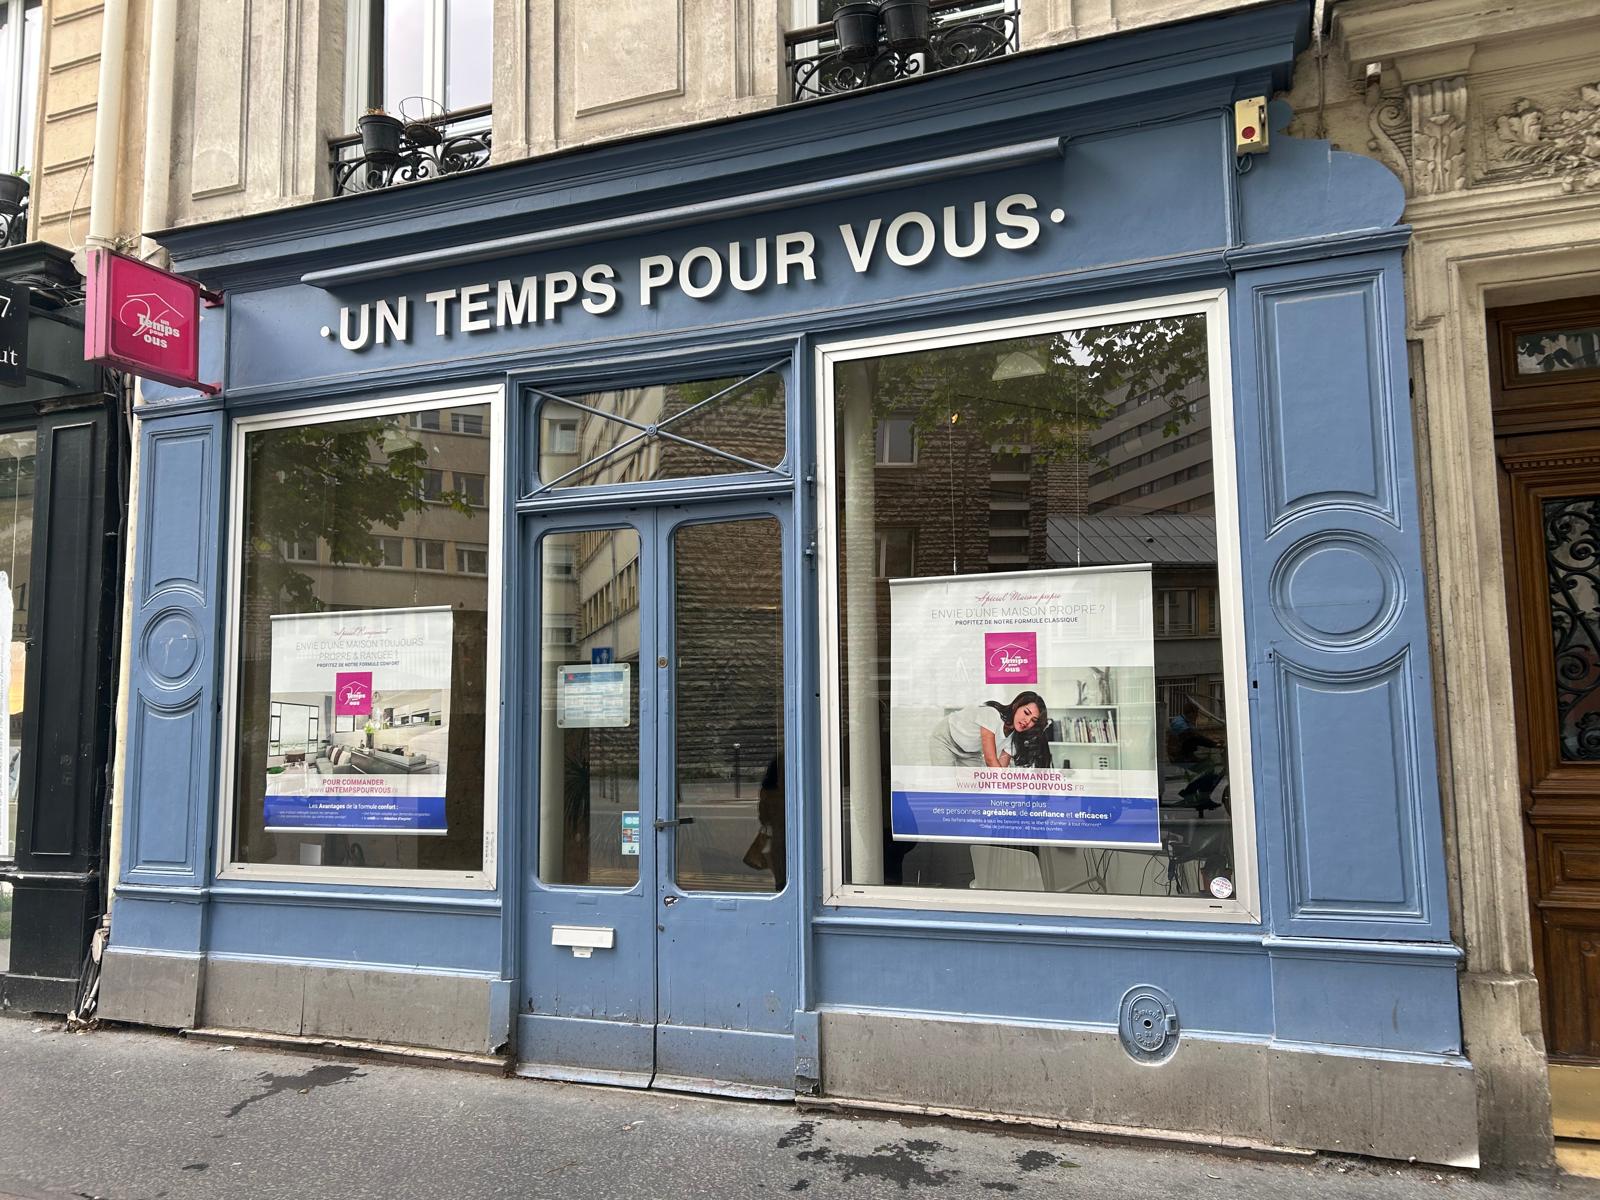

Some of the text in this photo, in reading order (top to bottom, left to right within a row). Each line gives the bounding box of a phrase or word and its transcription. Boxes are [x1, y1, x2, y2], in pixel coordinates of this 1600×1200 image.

[339, 193, 1040, 350] UN TEMPS POUR VOUS
[137, 313, 180, 337] Temps
[931, 608, 963, 619] ENVIE
[965, 607, 999, 618] D'UNE
[1001, 605, 1046, 617] MAISON
[1049, 604, 1097, 616] PROPRE
[295, 641, 318, 651] ENVIE
[346, 638, 378, 649] MAISON
[379, 636, 424, 648] TOUJOURS
[1000, 656, 1029, 666] Temps
[973, 771, 999, 780] POUR
[1000, 772, 1061, 781] COMMANDER
[322, 778, 341, 786] POUR
[341, 778, 385, 787] COMMANDER
[319, 803, 346, 811] Avantages
[358, 803, 378, 811] formule
[378, 803, 396, 811] confort
[990, 799, 1047, 809] Notre grand plus
[932, 807, 945, 815] des
[945, 808, 981, 817] personnes
[1019, 809, 1029, 817] de
[1029, 810, 1065, 819] confiance
[1065, 811, 1074, 819] et
[1074, 811, 1109, 821] efficaces
